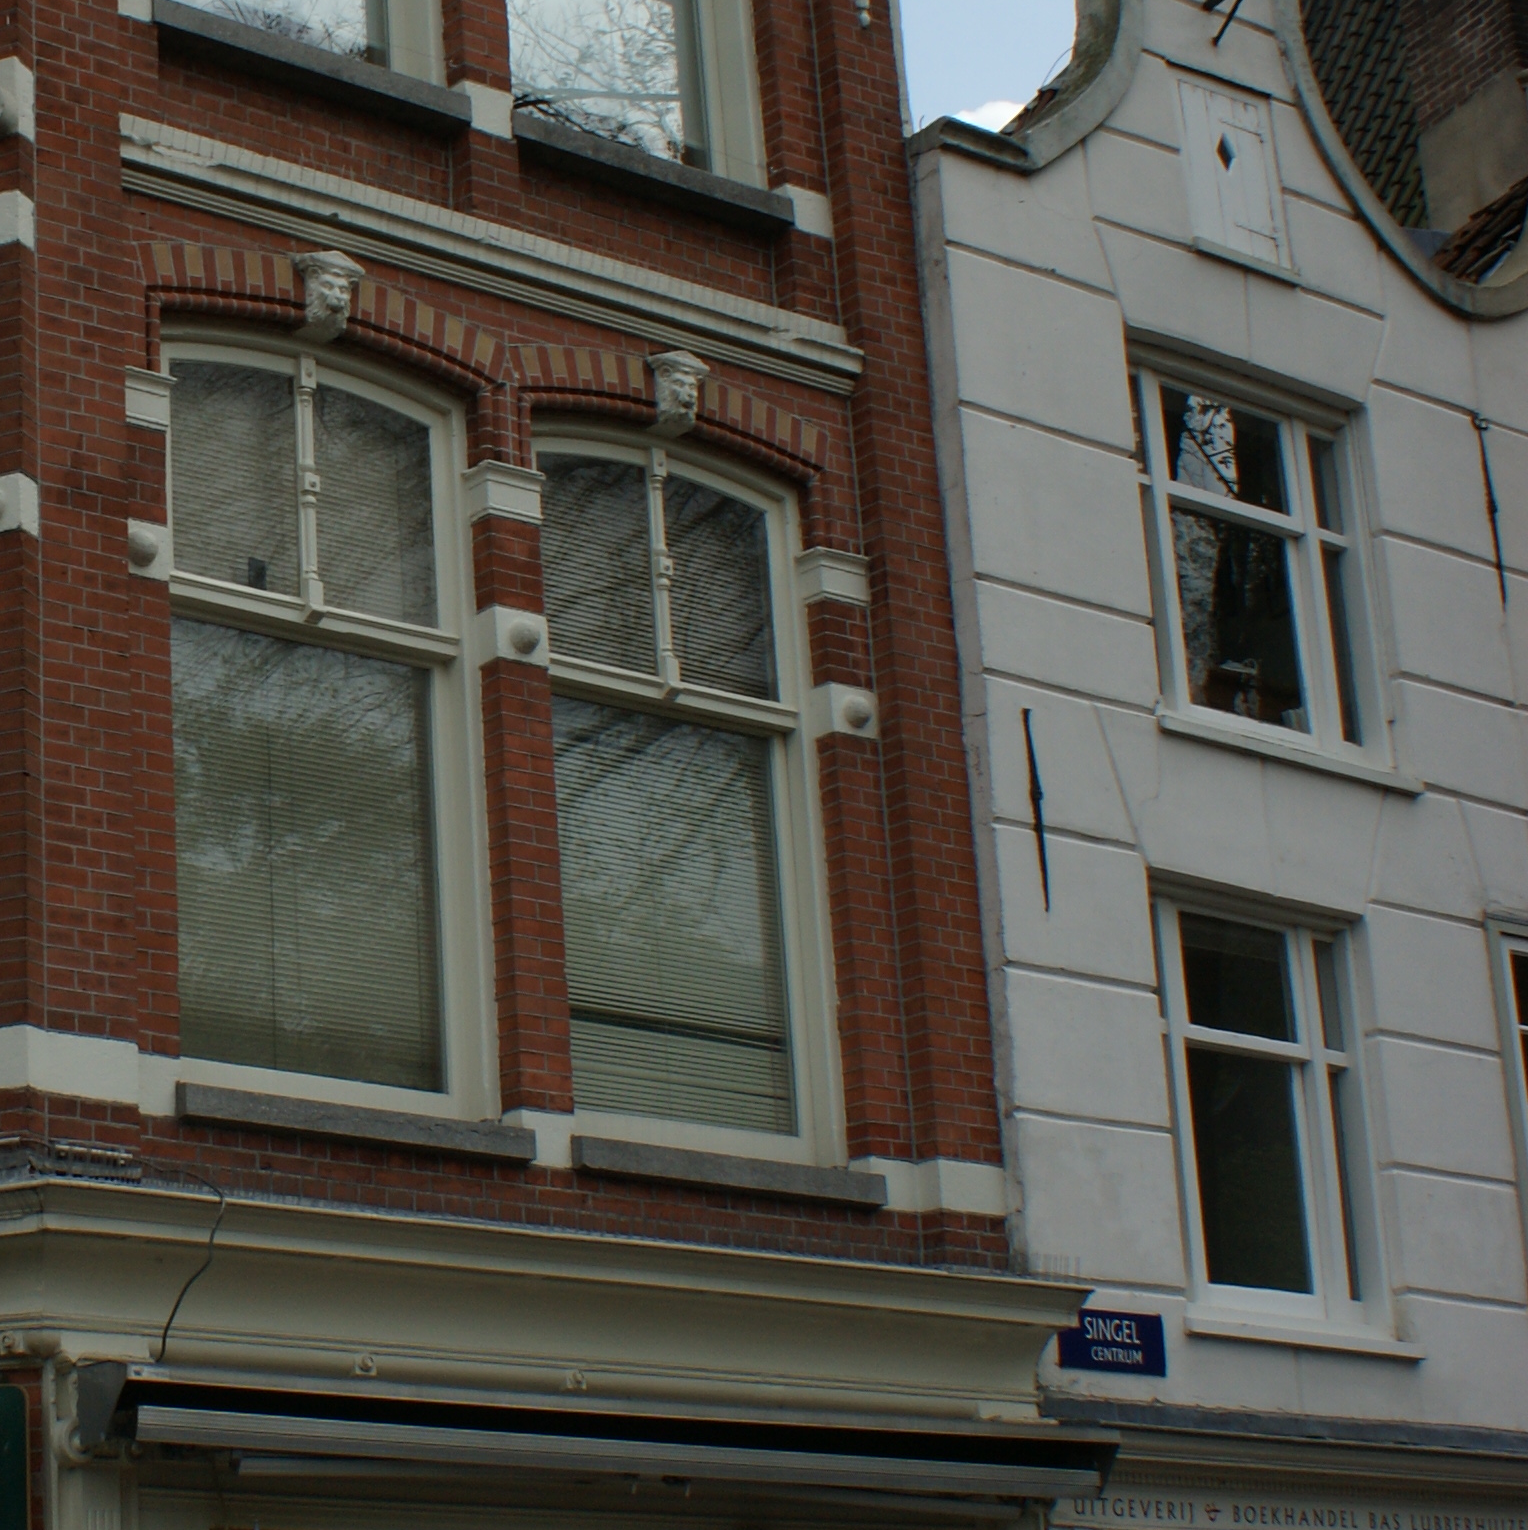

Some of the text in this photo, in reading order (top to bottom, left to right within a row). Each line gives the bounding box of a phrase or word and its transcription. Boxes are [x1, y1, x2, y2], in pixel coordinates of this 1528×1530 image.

[1084, 1316, 1141, 1345] SINGEL
[1091, 1346, 1143, 1364] CENTRUM
[1074, 1497, 1193, 1524] UITGEVERIJ
[1232, 1504, 1358, 1529] BOEKHANDEL
[1369, 1511, 1401, 1530] BAS
